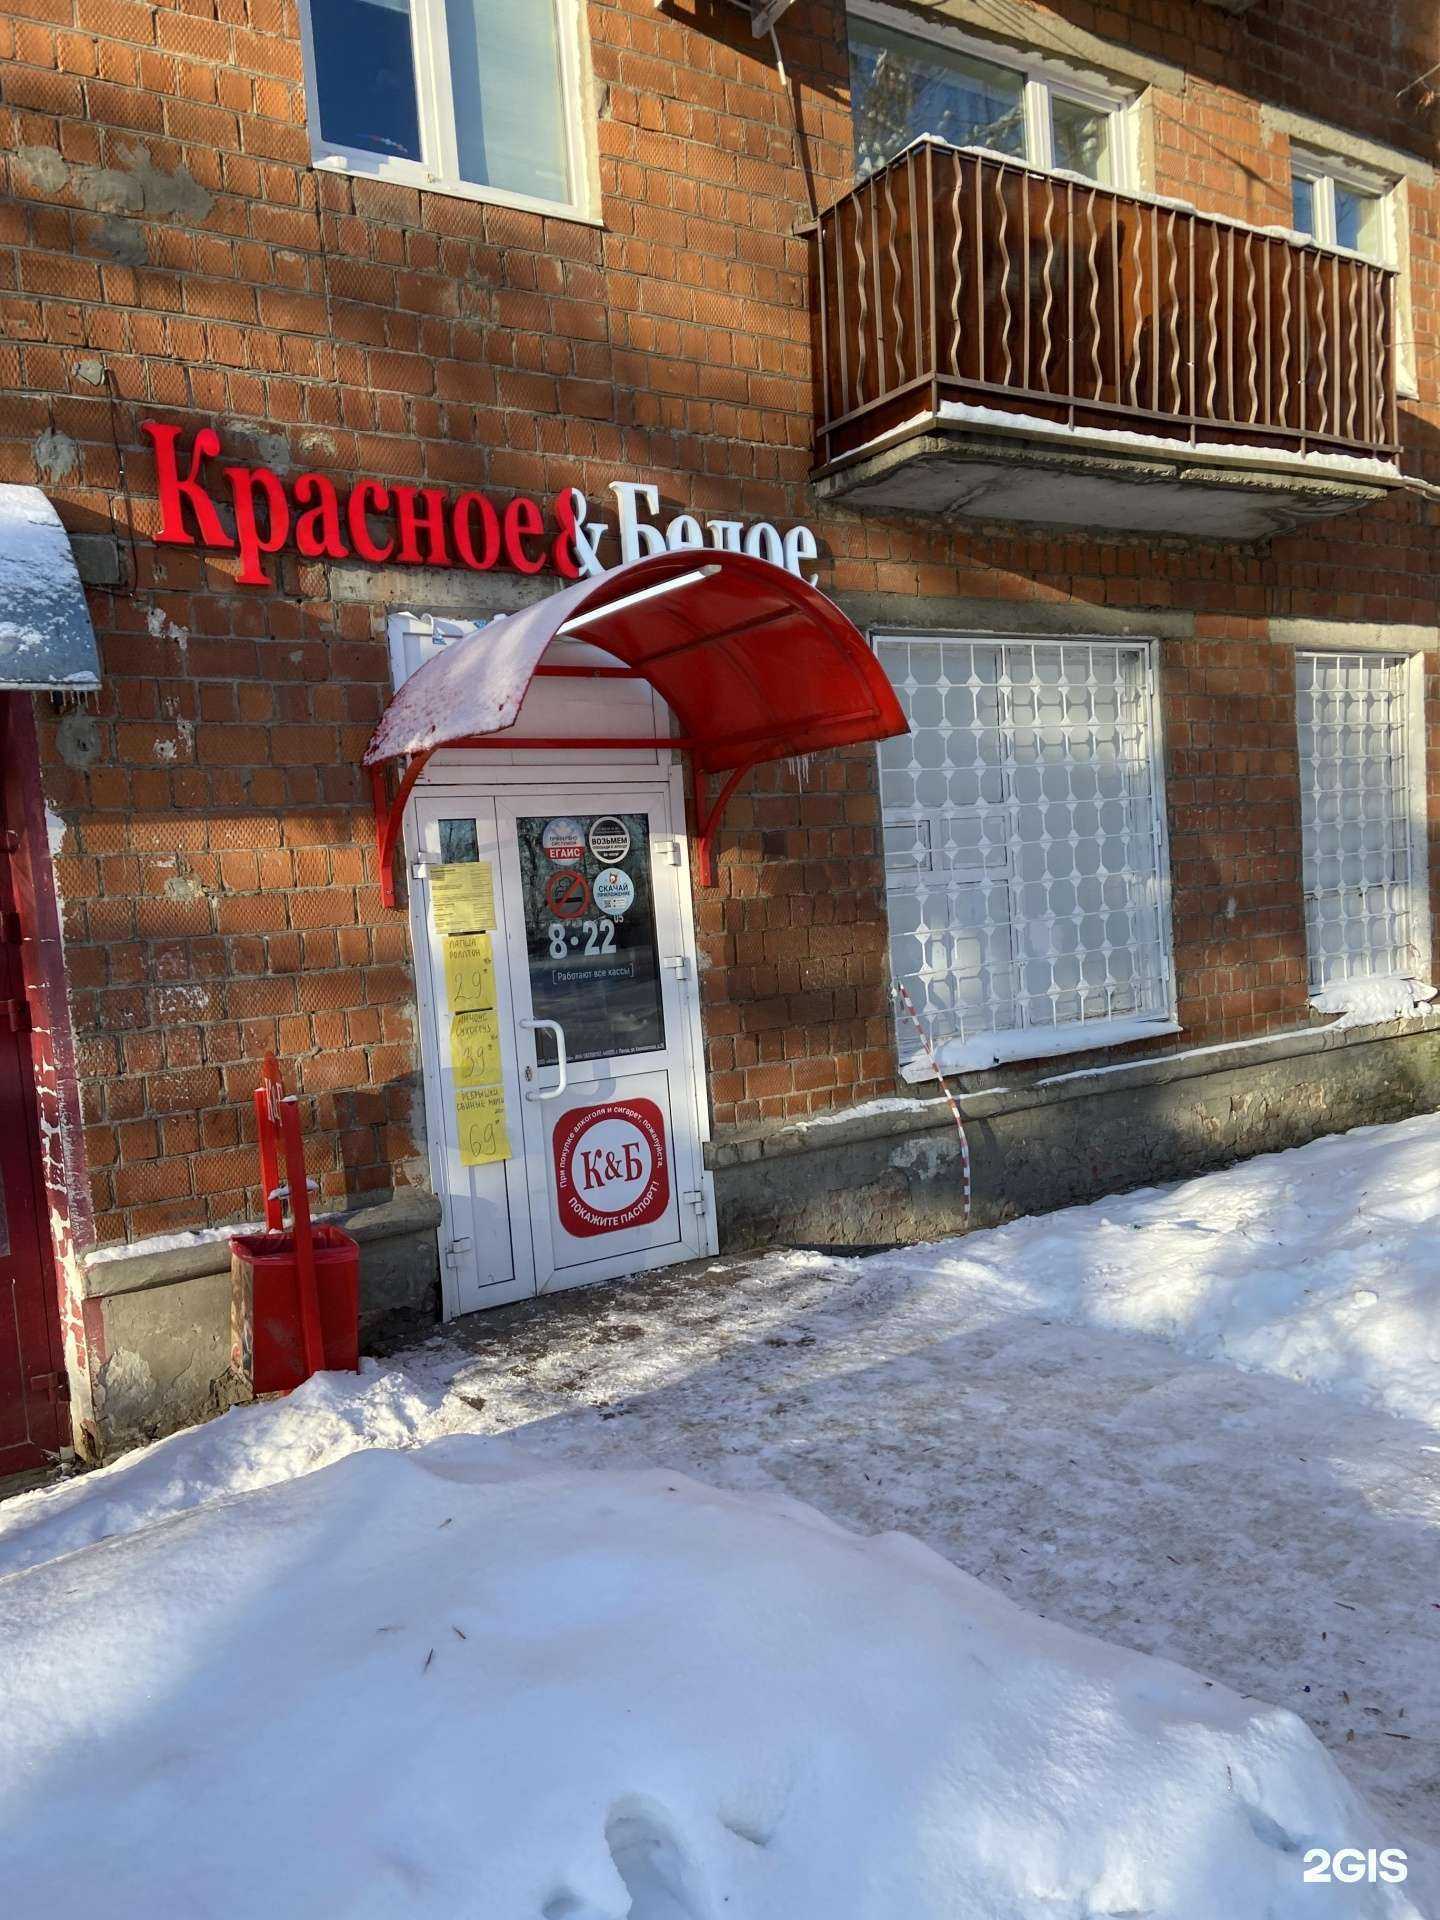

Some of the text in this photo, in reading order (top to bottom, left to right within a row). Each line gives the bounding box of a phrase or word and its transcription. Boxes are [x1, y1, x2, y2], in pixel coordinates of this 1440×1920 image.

[141, 421, 545, 586] Красное
[549, 848, 581, 859] ЕГАИС
[592, 836, 628, 846] ВОЗЬМЕМ
[598, 883, 629, 893] СКАЧАЙ
[593, 969, 606, 978] все
[560, 1132, 575, 1169] покупке
[574, 1108, 606, 1133] алкоголя
[613, 1106, 643, 1122] сигарет,
[581, 1142, 643, 1190] К&Б
[568, 1181, 660, 1227] ПОКАЖИТЕ ПАСПОРТ!
